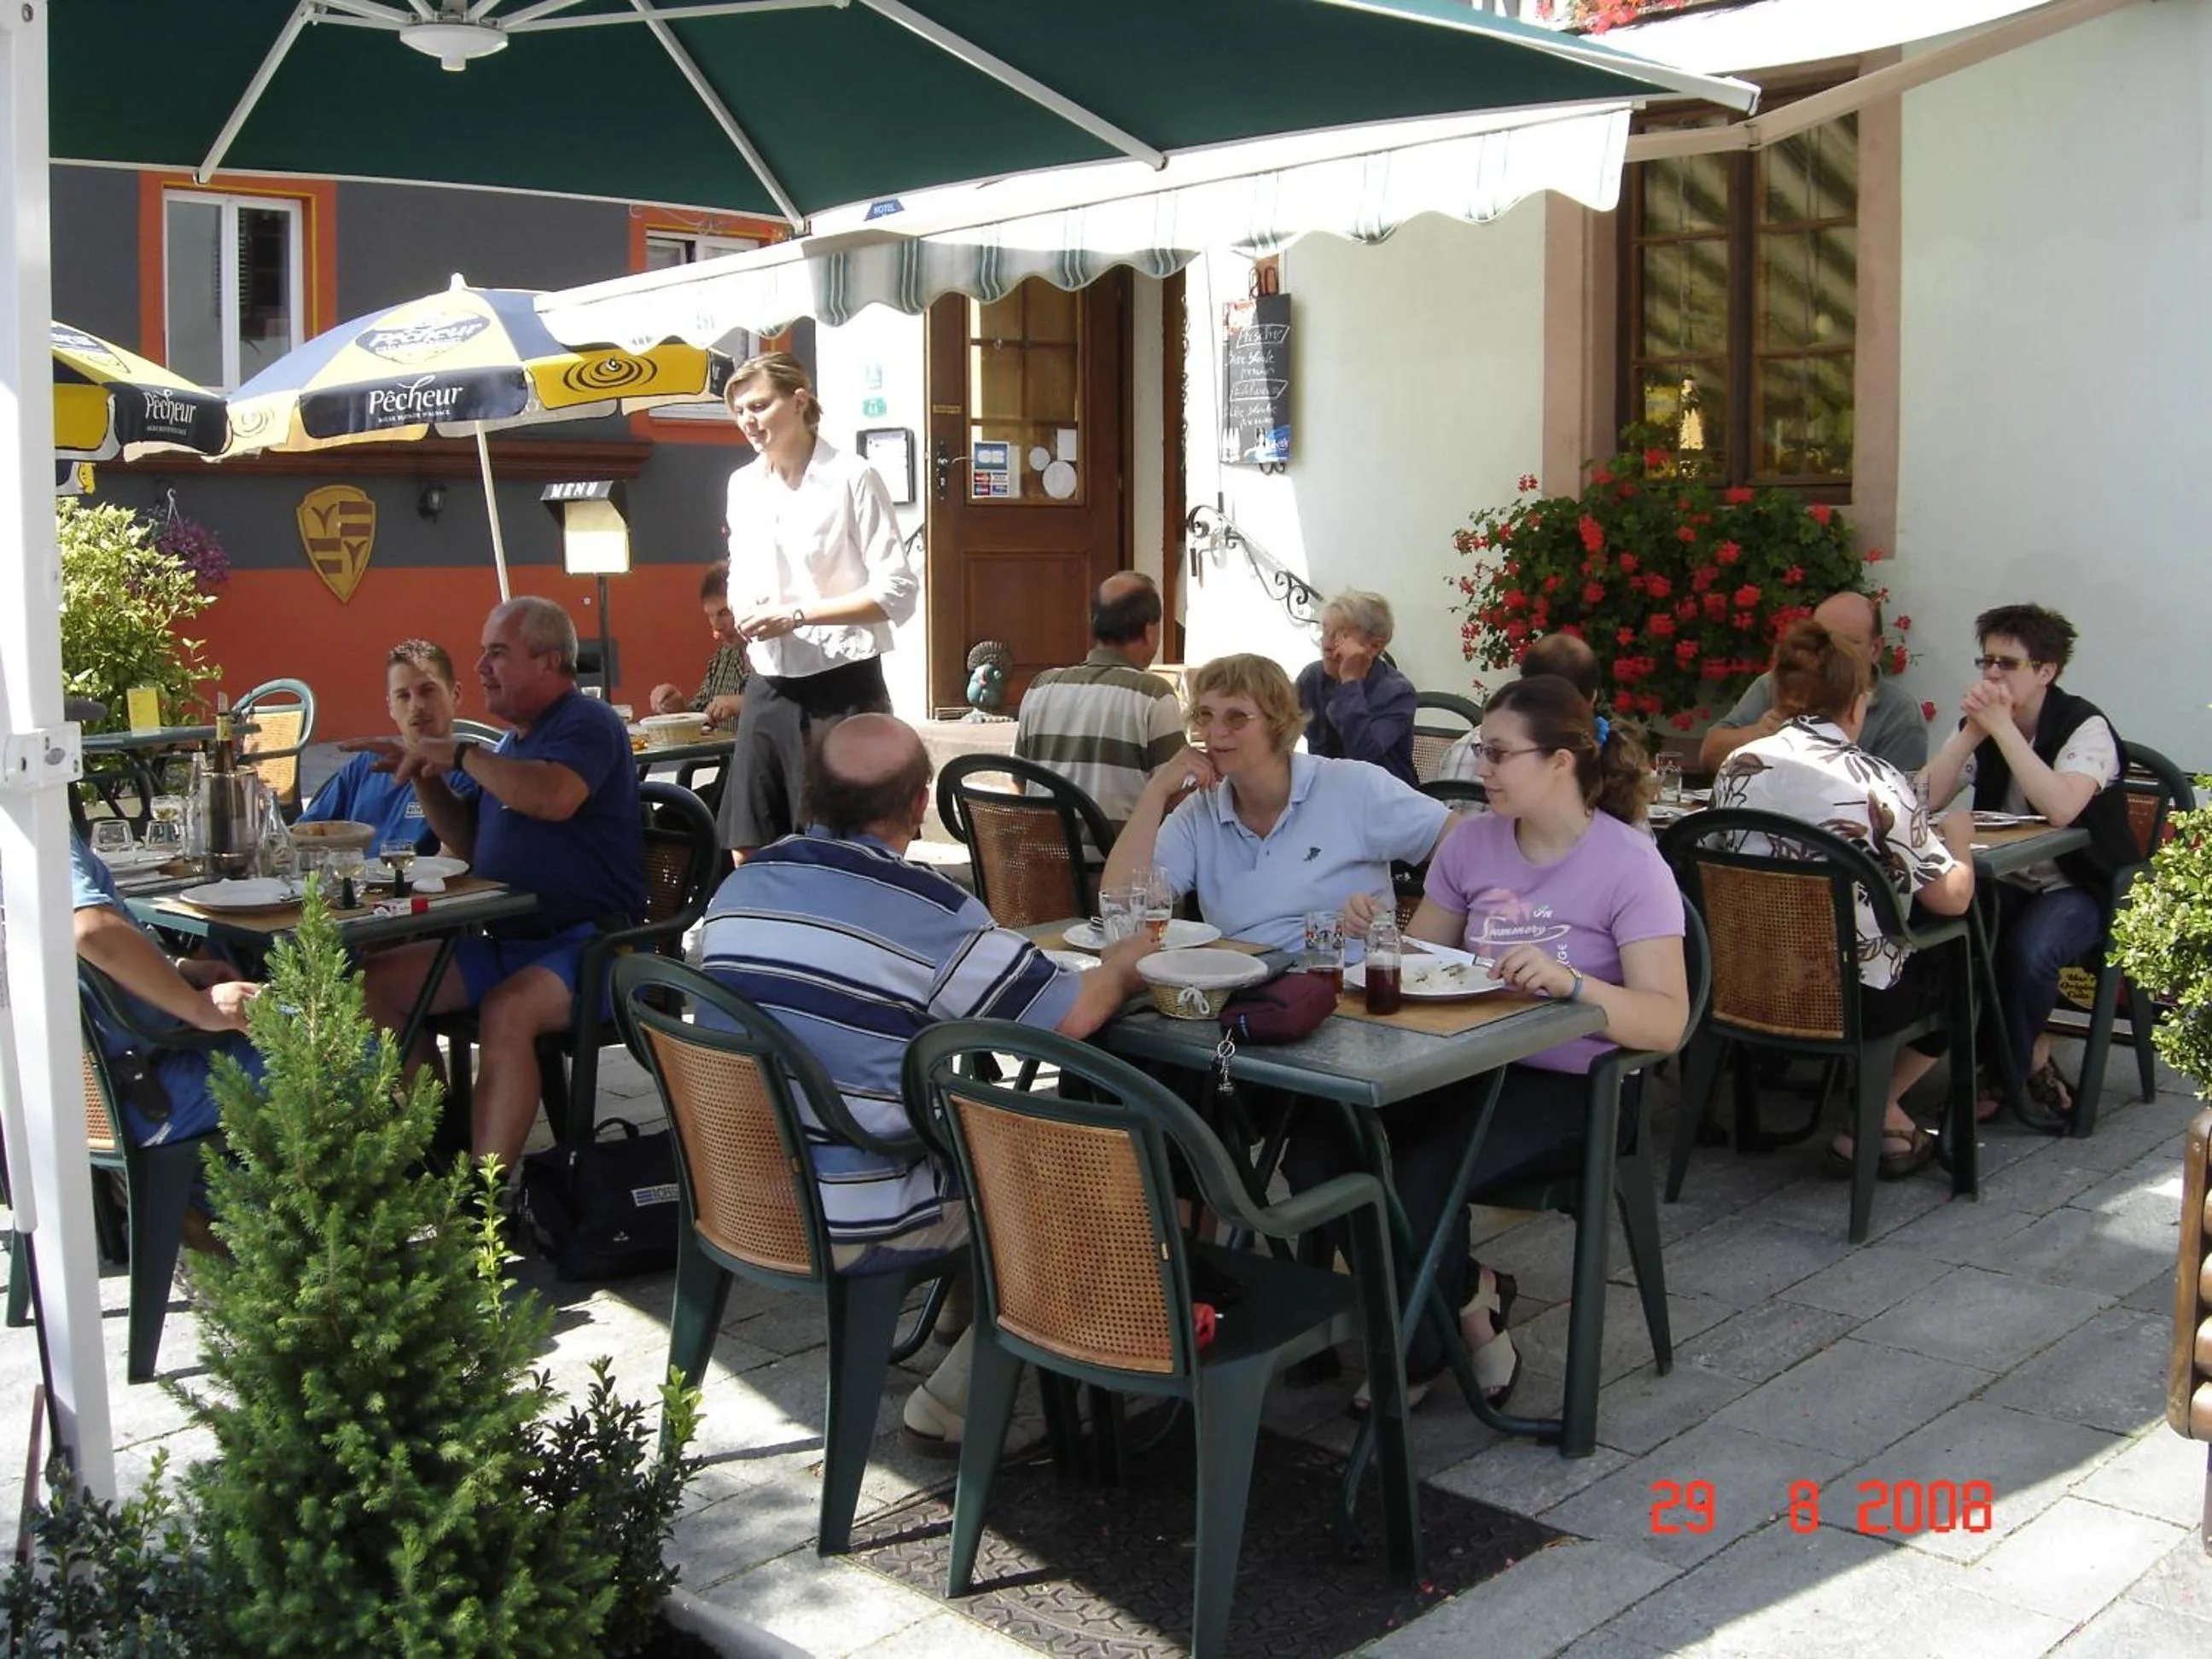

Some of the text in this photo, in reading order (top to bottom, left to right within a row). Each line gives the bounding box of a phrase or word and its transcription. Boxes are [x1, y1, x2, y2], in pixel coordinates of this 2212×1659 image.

[143, 388, 197, 425] Pêcheur
[369, 375, 464, 415] Pêcheur
[550, 481, 598, 498] MENU
